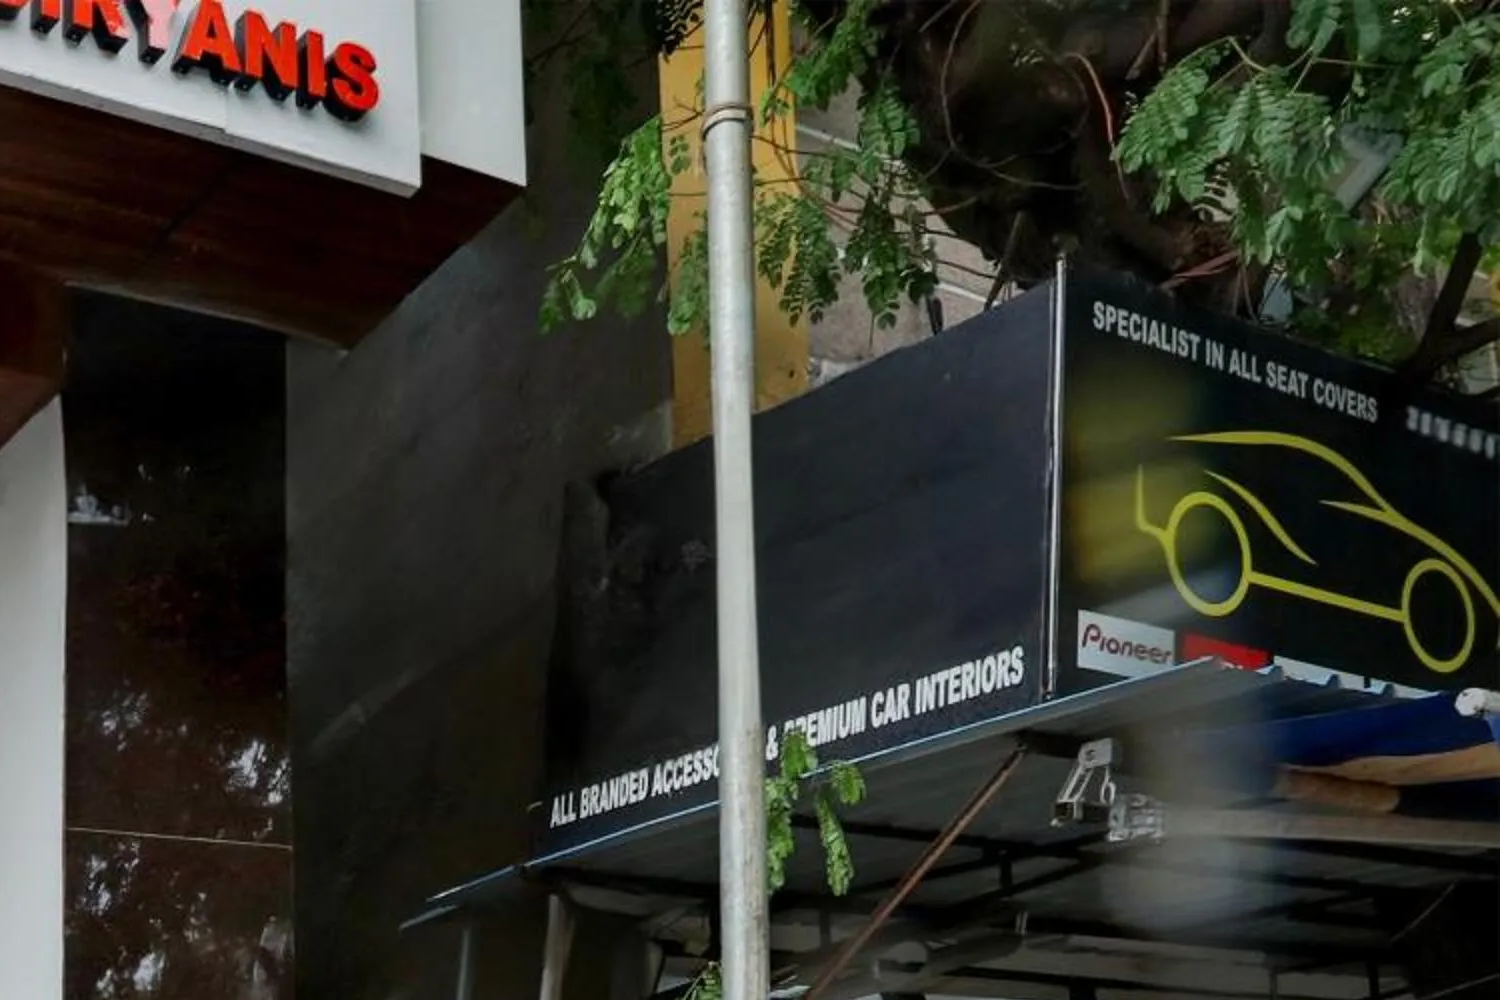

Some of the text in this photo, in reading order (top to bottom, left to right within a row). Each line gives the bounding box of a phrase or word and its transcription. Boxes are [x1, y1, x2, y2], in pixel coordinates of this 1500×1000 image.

[1092, 301, 1378, 423] SPECIALIST IN ALL SEAT COVERS
[1082, 623, 1173, 664] Pioneer
[550, 790, 577, 828] ALL
[579, 768, 650, 819] BRANDED
[765, 725, 779, 761] &
[784, 696, 866, 747] EMIUM
[871, 683, 910, 728] CAR
[915, 646, 1024, 715] INTERIORS
